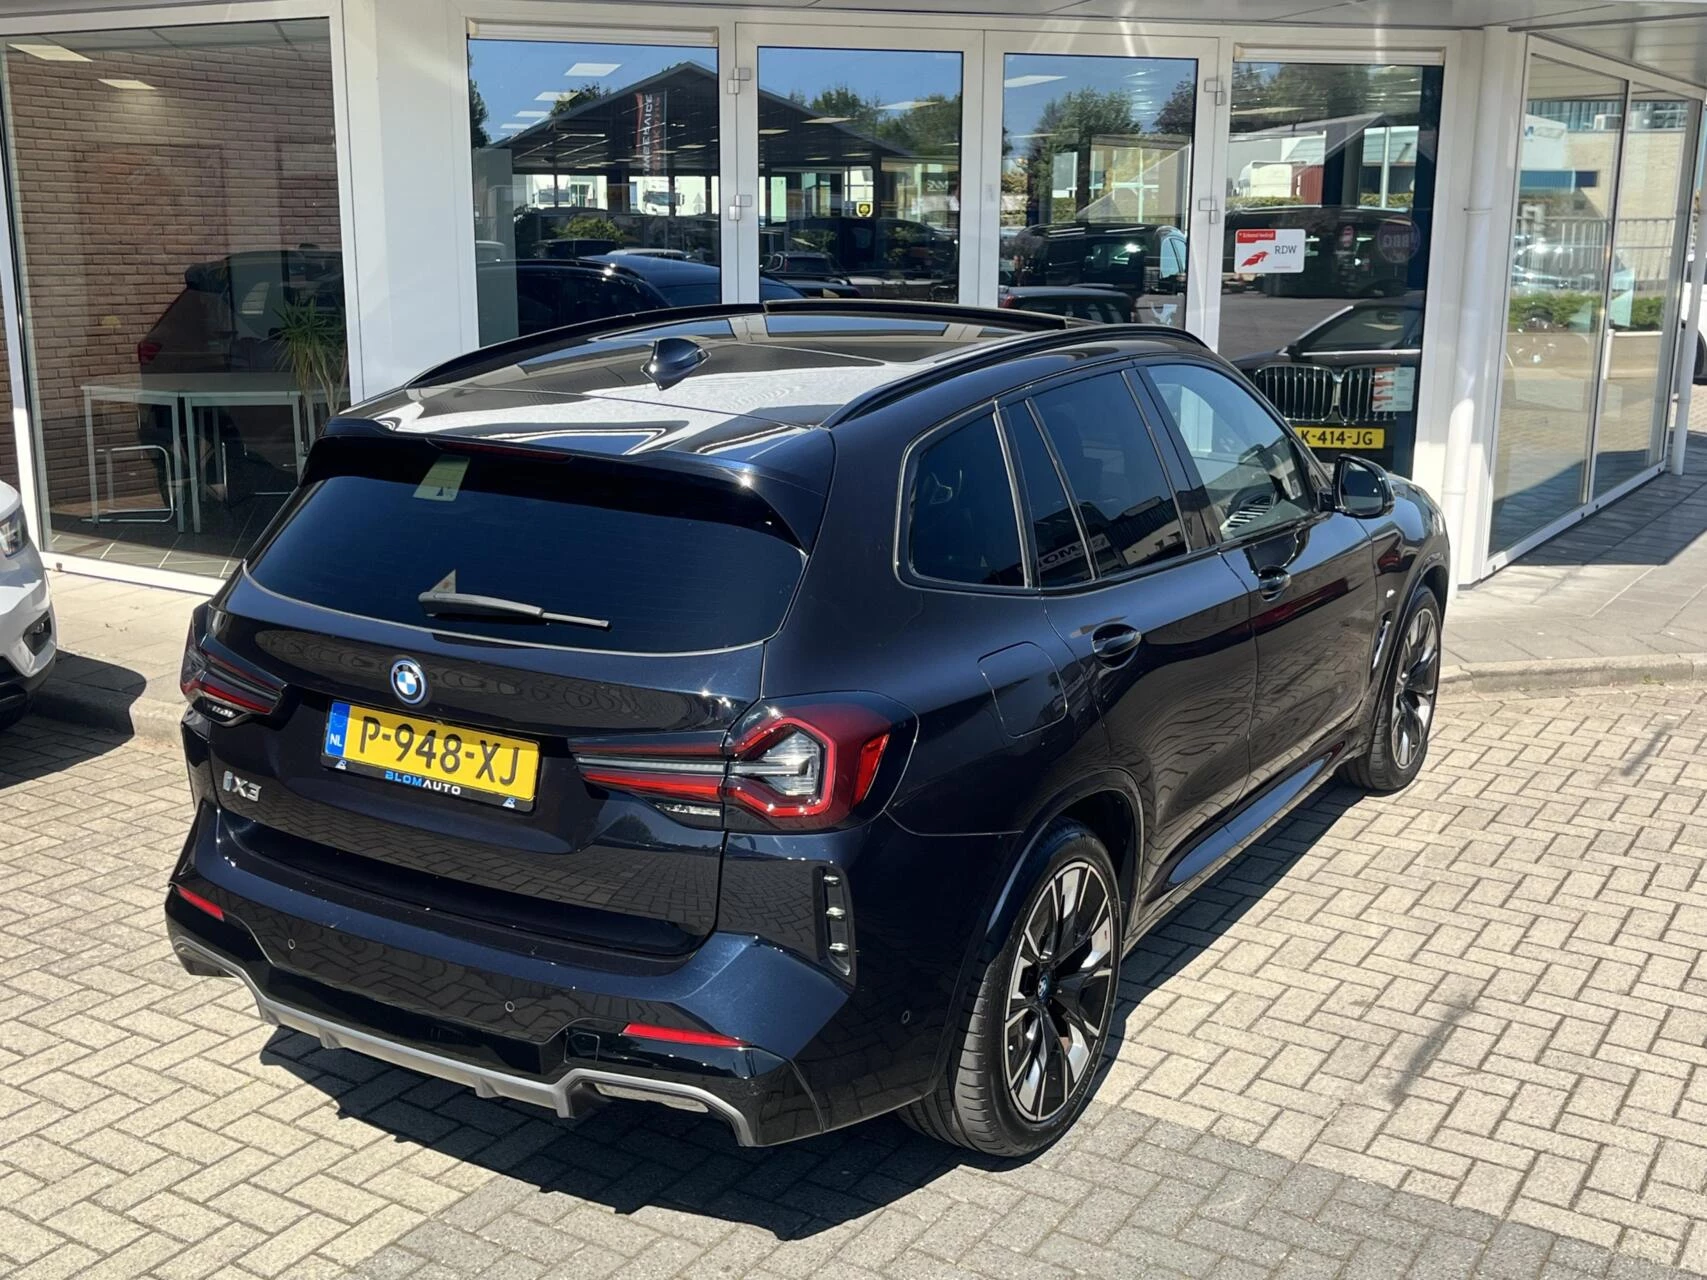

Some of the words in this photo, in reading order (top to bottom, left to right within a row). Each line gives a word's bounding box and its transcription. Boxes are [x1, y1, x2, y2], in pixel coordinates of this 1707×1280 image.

[1274, 244, 1298, 255] RDW
[1301, 430, 1373, 445] K-414-JG
[329, 733, 343, 747] NL
[359, 716, 520, 787] P-948-XJ
